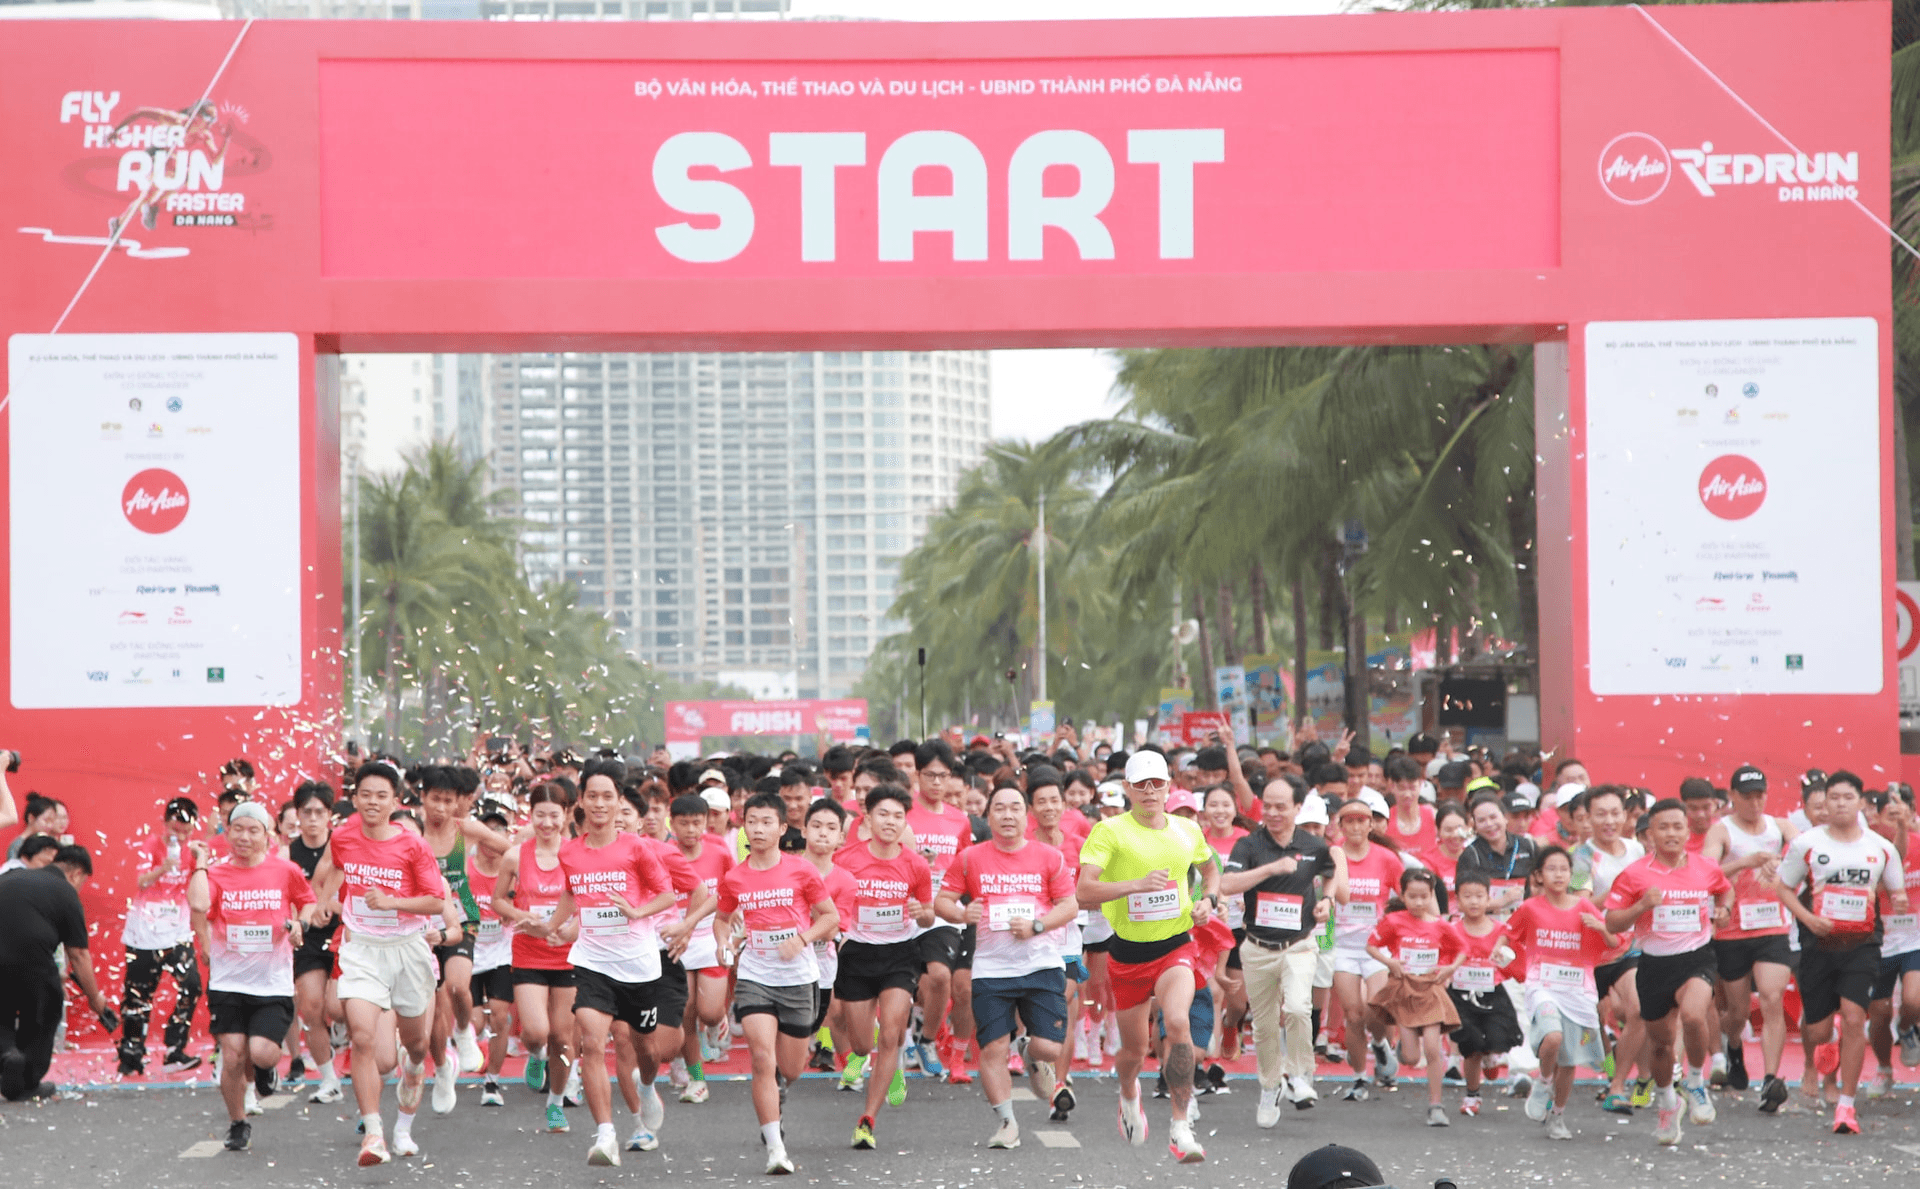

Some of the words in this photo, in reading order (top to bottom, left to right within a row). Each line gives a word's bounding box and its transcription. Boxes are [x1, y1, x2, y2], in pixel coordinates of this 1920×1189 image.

[634, 77, 663, 100] BỘ
[666, 78, 706, 97] VĂN
[710, 78, 758, 98] HÓA,
[761, 77, 798, 96] THỂ
[801, 80, 855, 96] THAO
[858, 78, 885, 97] VÀ
[889, 80, 917, 96] DU
[921, 79, 964, 99] LỊCH
[980, 79, 1036, 95] UBND
[1039, 75, 1106, 94] THÀNH
[1109, 73, 1152, 94] PHỐ
[1155, 74, 1184, 93] ĐÀ
[1187, 71, 1243, 93] NẴNG
[60, 90, 120, 123] FLY
[83, 125, 187, 148] HIGHER
[116, 149, 224, 191] RUN
[652, 128, 1225, 263] START
[1778, 185, 1804, 202] DA
[1807, 185, 1859, 201] NANG
[166, 193, 244, 212] FASTER
[175, 214, 196, 226] DA
[198, 214, 235, 226] NANG
[1702, 473, 1764, 501] AirAsia
[126, 487, 187, 515] AirAsia
[731, 711, 802, 732] FINISH
[358, 864, 403, 881] HIGHER
[583, 871, 627, 884] HIGHER
[980, 874, 996, 884] FLY
[997, 873, 1042, 884] HIGHER
[239, 889, 282, 901] HIGHER
[588, 882, 627, 894] FASTER
[753, 888, 794, 901] HIGHER
[981, 884, 1001, 894] RUN
[1003, 883, 1042, 894] FASTER
[243, 900, 282, 910] FASTER
[758, 897, 794, 909] FASTER
[1148, 894, 1176, 904] 53930
[640, 1006, 657, 1027] 73
